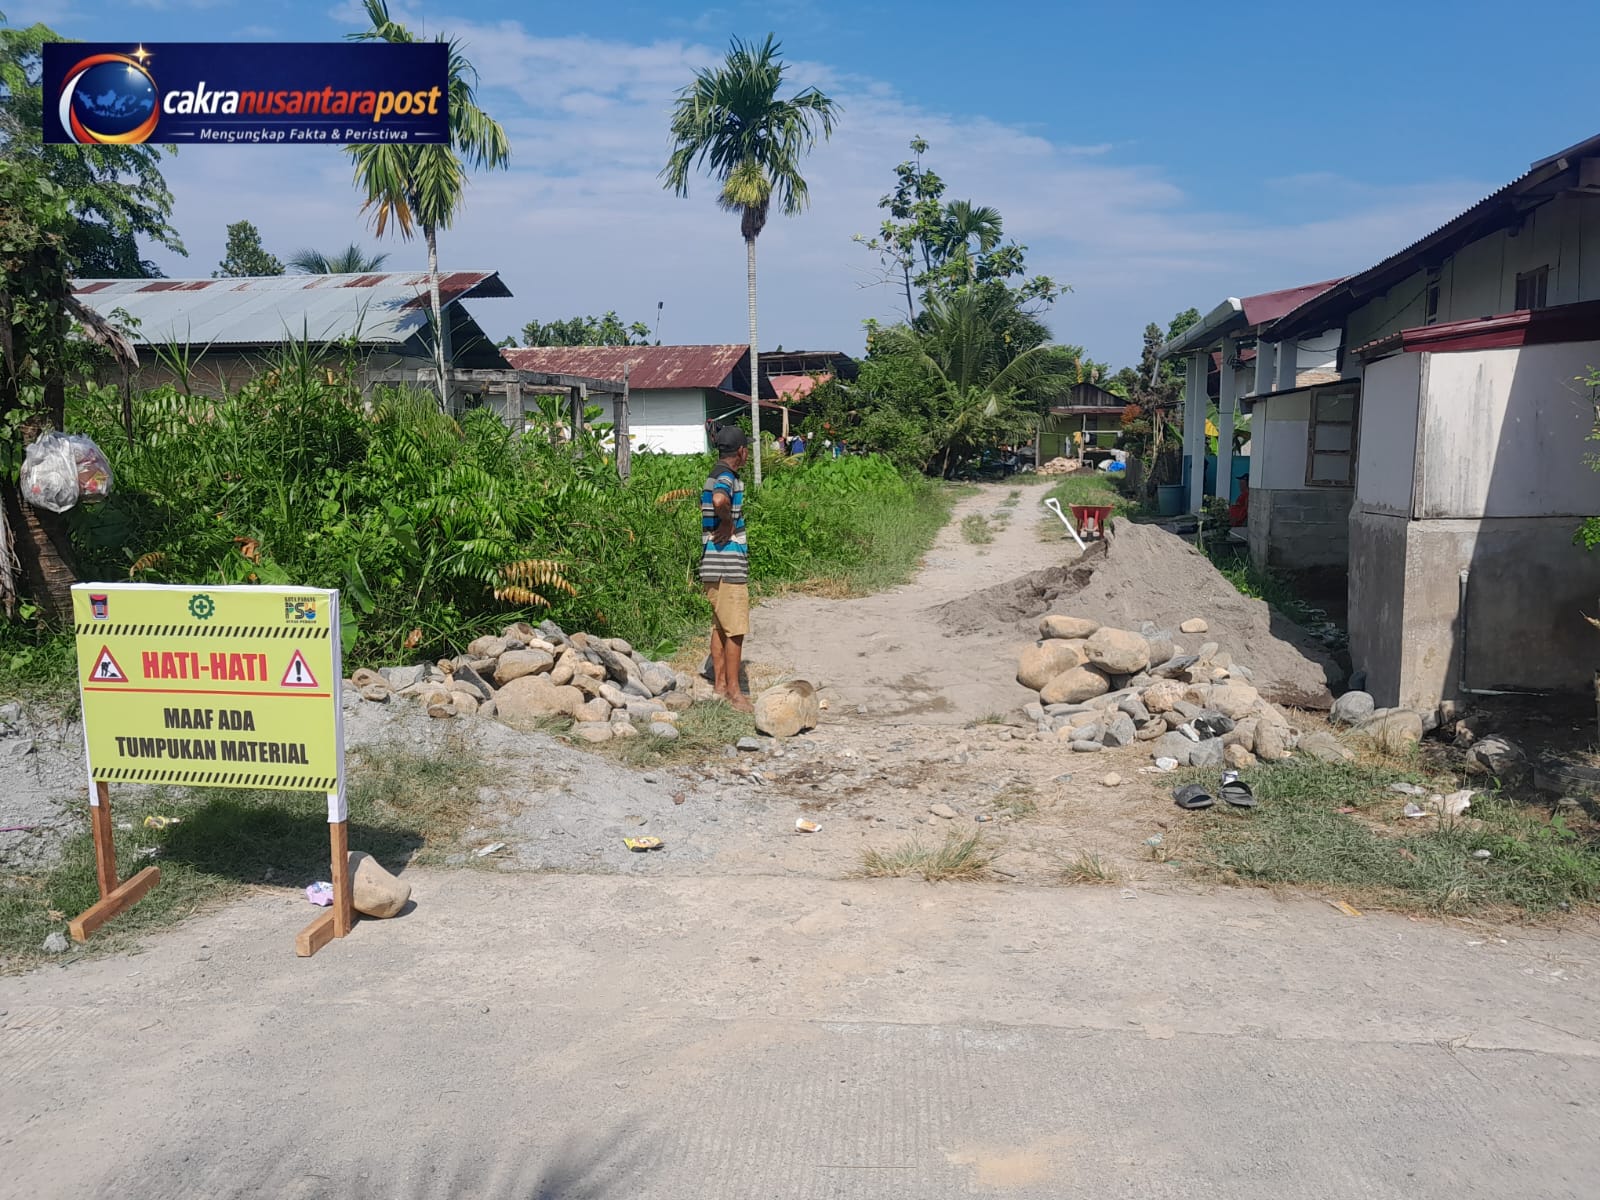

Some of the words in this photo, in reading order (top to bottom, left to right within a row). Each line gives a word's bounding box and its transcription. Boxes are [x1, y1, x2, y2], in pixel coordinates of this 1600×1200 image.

[142, 652, 268, 681] HATI-HATI
[164, 708, 213, 729] MAAF
[218, 710, 255, 731] ADA
[115, 737, 216, 760] TUMPUKAN
[221, 740, 309, 764] MATERIAL
